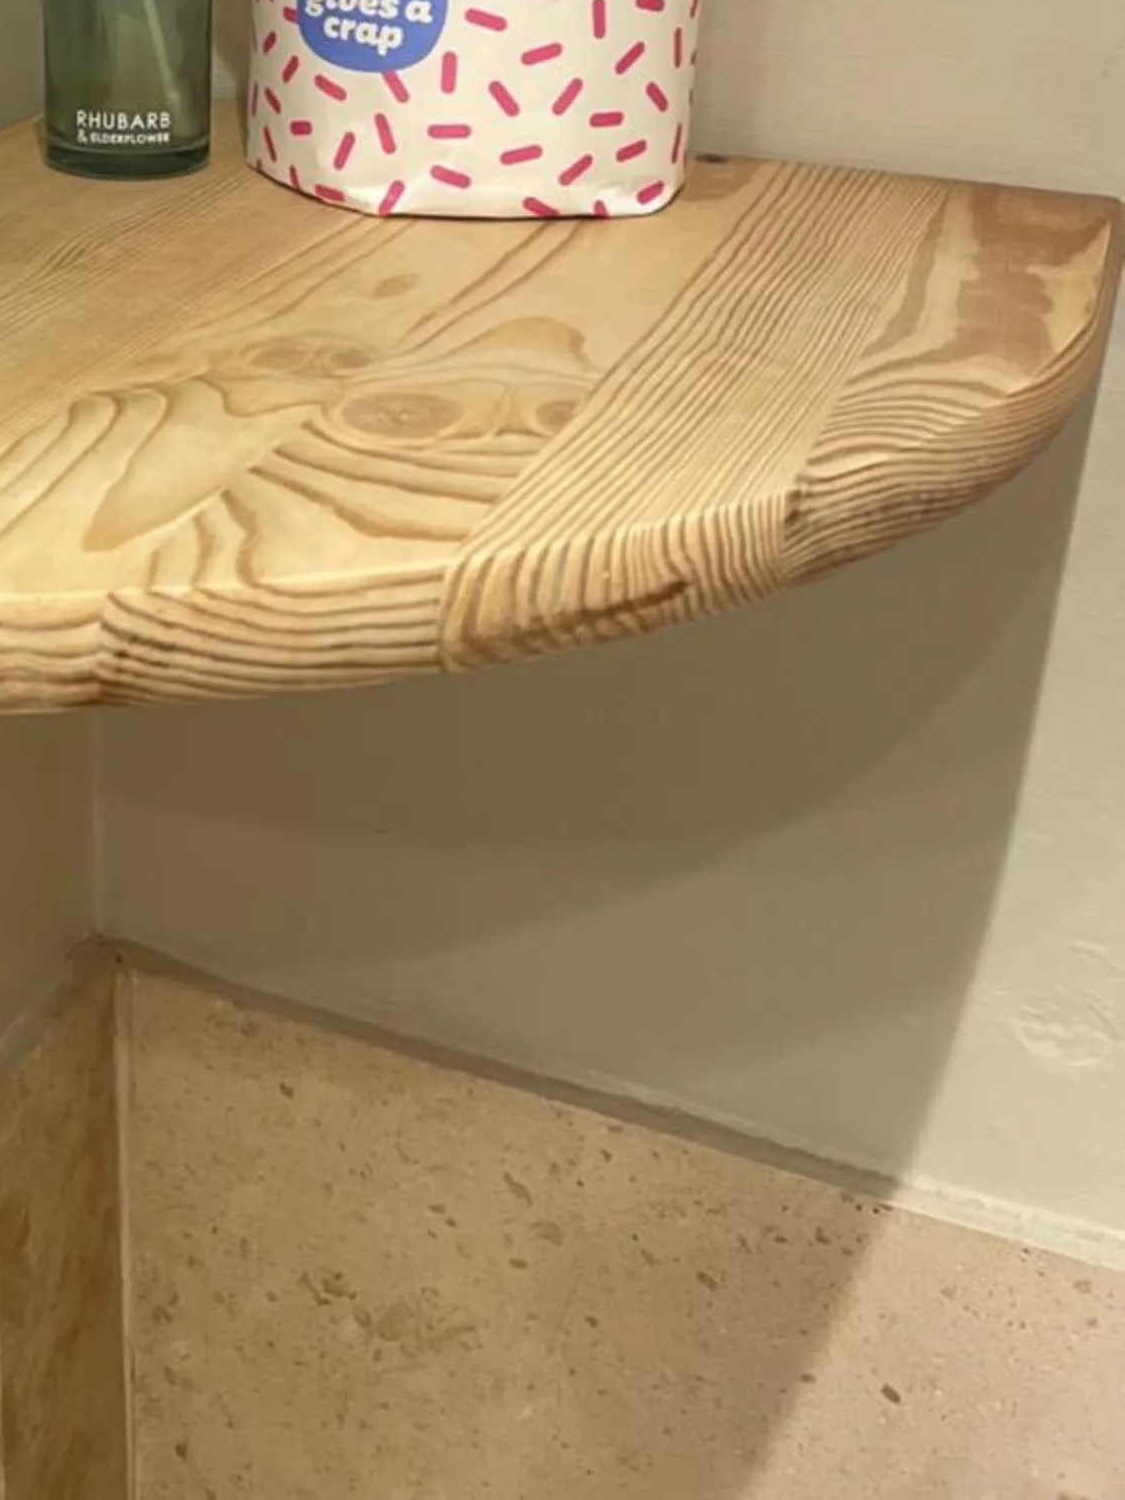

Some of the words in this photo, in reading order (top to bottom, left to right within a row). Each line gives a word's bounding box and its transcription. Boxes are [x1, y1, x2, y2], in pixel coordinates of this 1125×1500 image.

[323, 15, 404, 56] crap
[76, 109, 171, 130] RHUBARB
[77, 129, 88, 143] &
[90, 132, 170, 145] ELDERFLOWER
